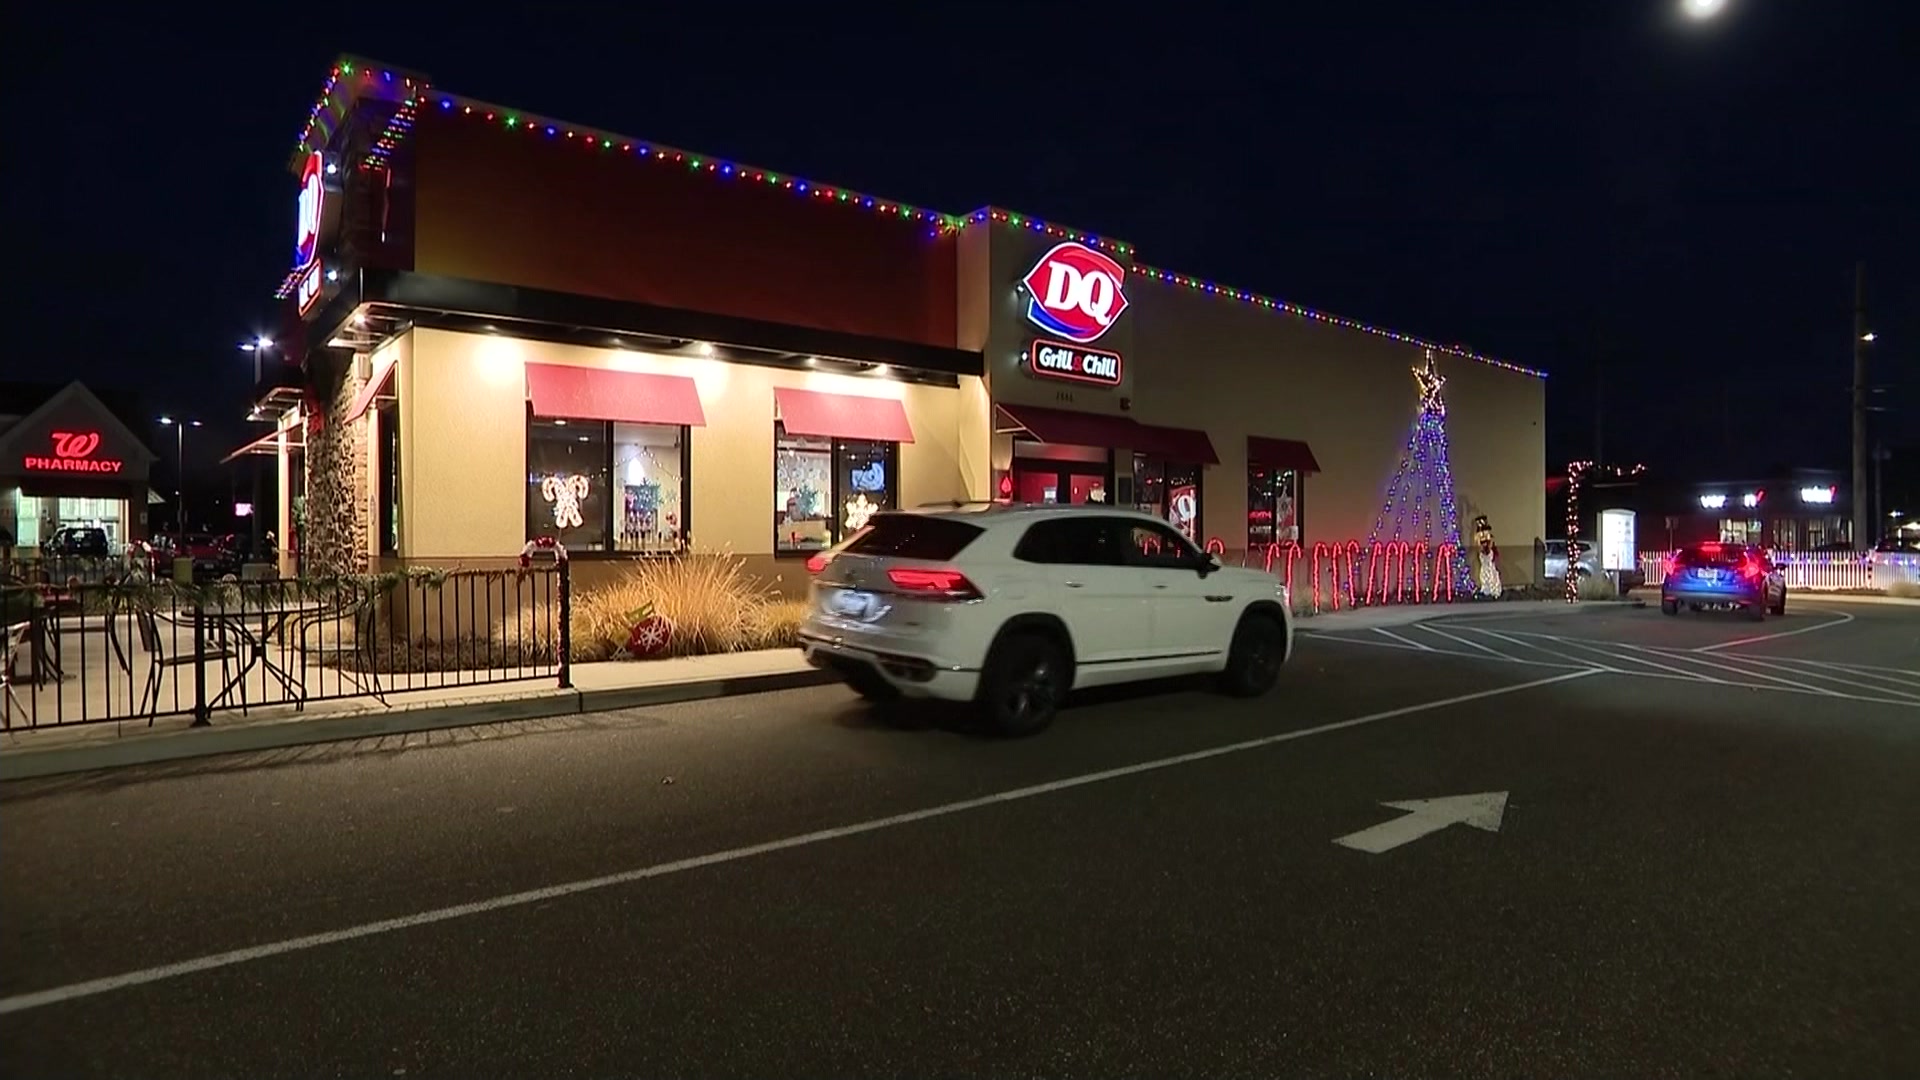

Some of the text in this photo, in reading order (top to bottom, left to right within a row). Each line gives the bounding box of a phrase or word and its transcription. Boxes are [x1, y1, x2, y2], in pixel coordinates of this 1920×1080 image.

[1044, 260, 1114, 326] DQ
[1039, 346, 1073, 371] Grill
[1083, 354, 1116, 378] Chill
[25, 457, 122, 472] PHARMACY
